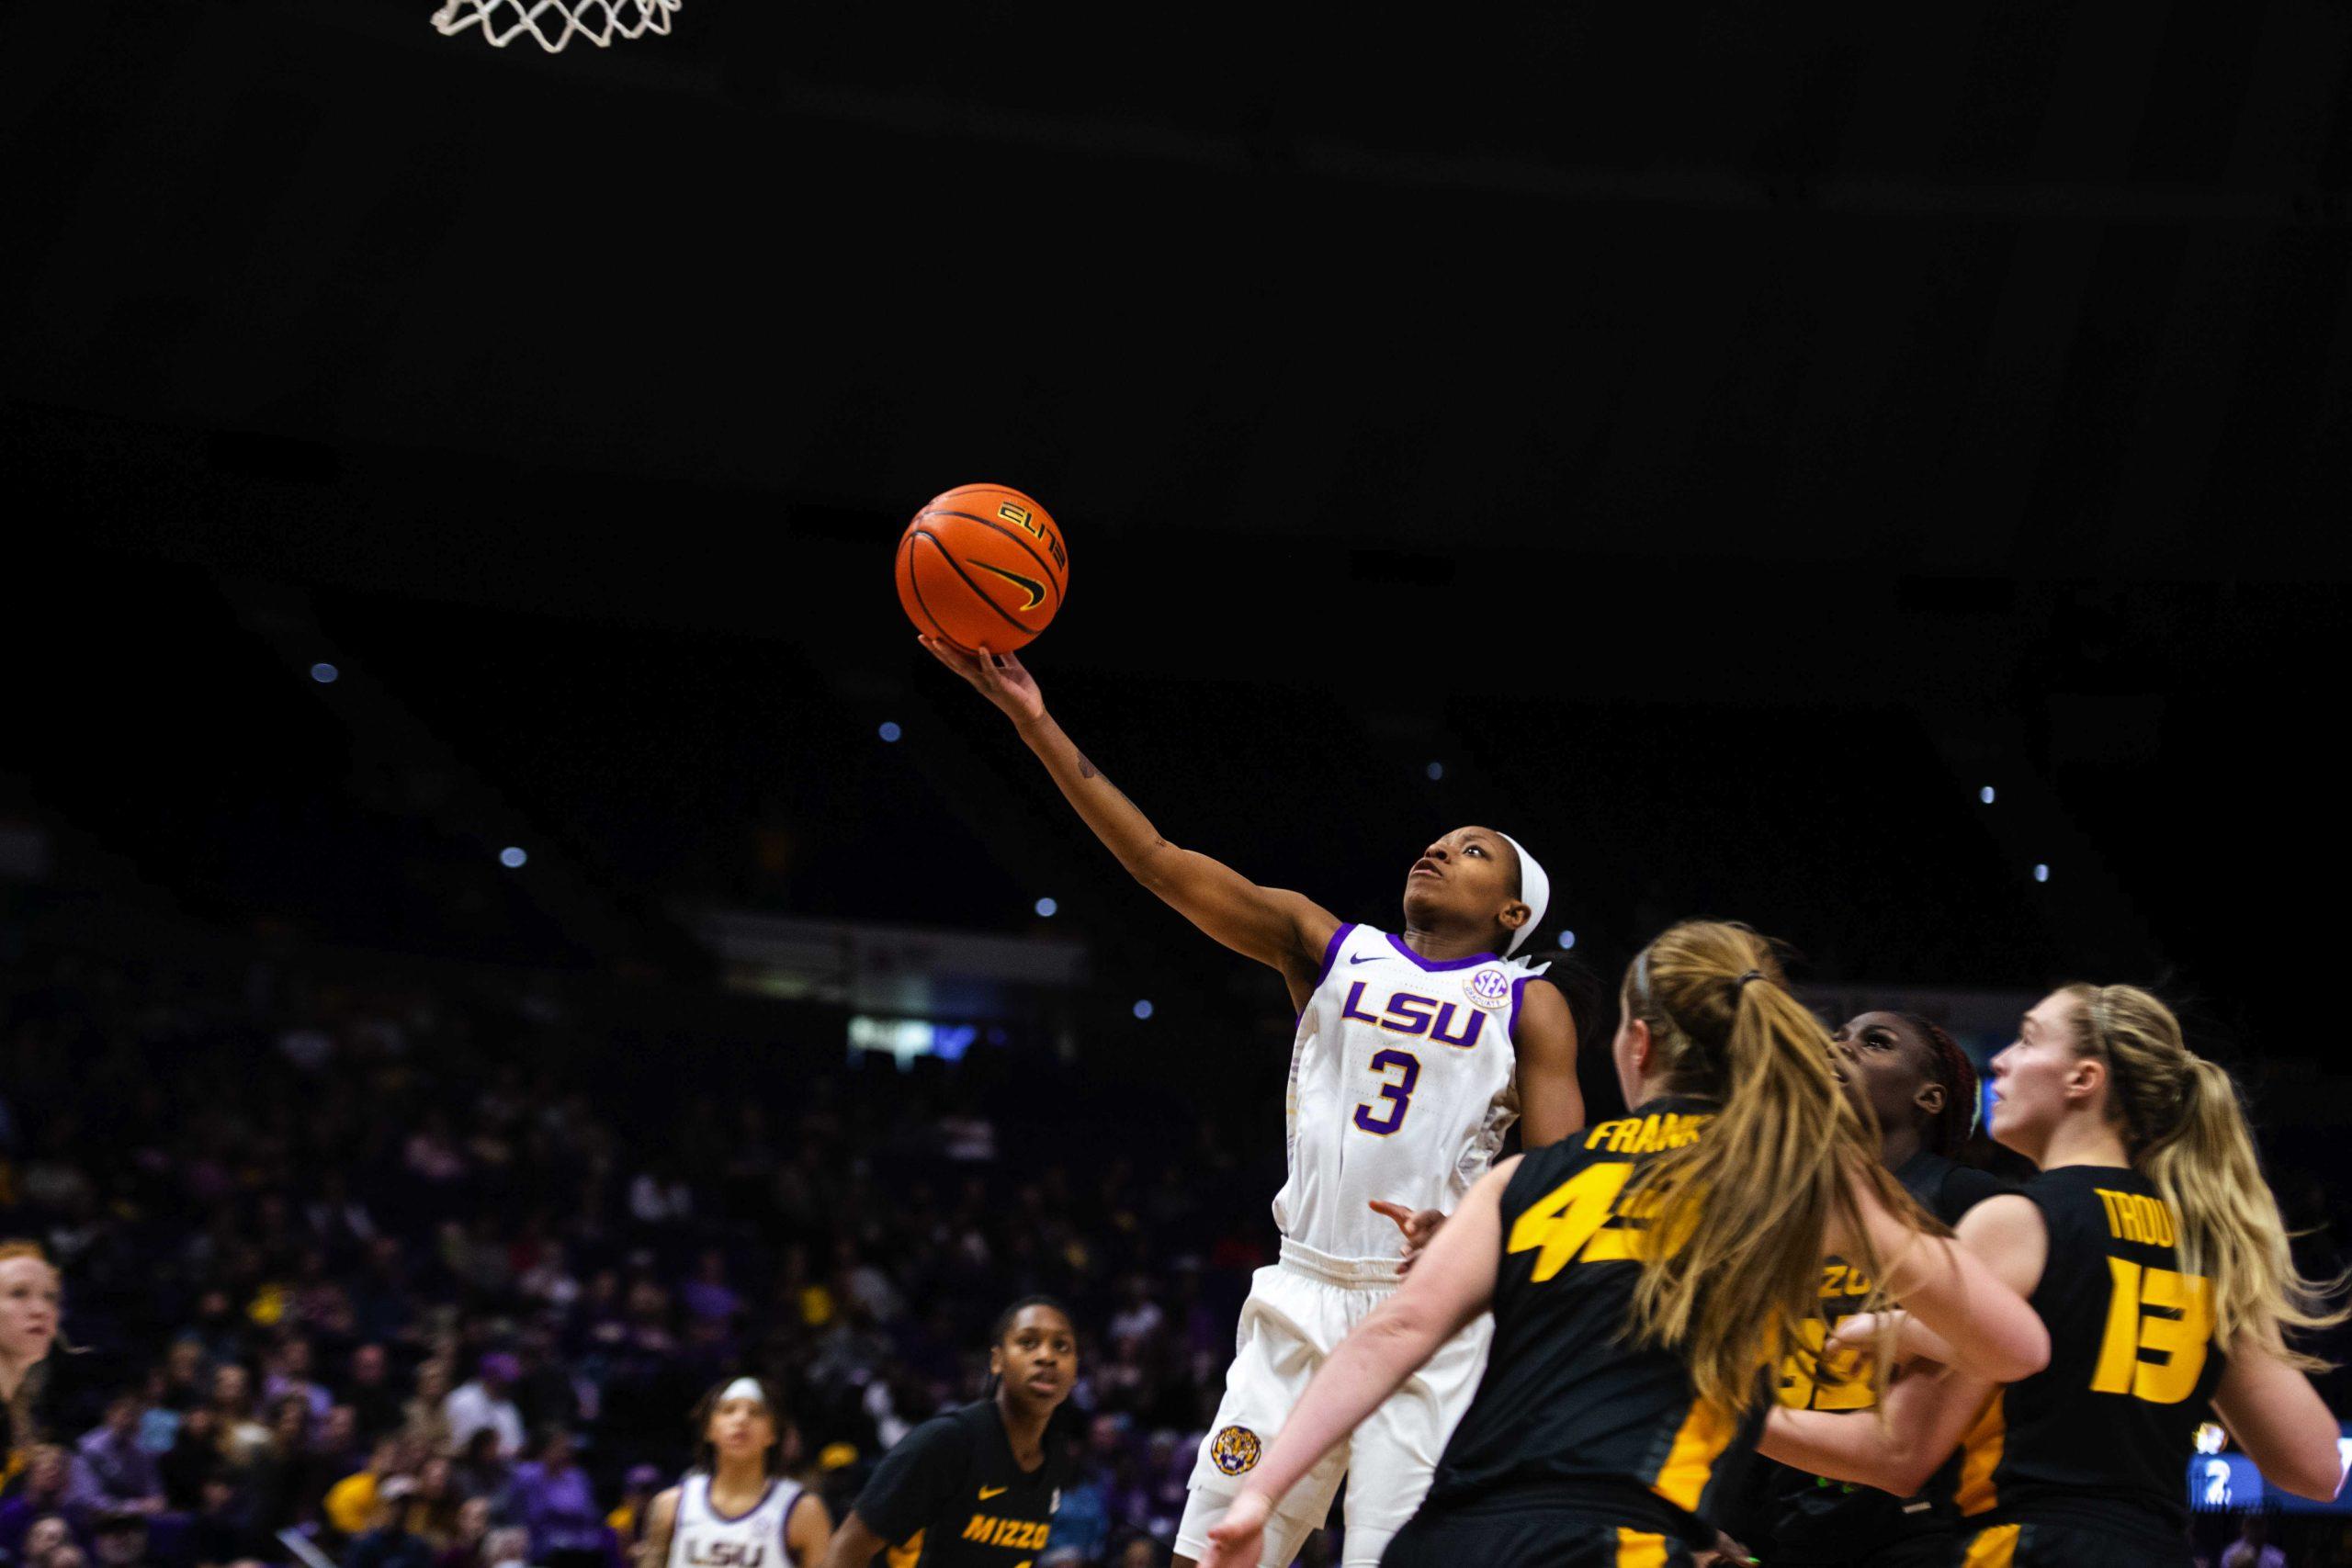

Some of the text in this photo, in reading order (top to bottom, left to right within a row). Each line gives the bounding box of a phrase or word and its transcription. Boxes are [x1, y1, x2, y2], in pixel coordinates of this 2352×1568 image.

[998, 501, 1066, 572] ELITE
[1341, 980, 1487, 1050] LSU
[1474, 970, 1508, 998] SEC
[1352, 1048, 1420, 1137] 3
[2089, 1256, 2217, 1404] 13
[685, 1540, 765, 1568] LSU
[962, 1515, 1051, 1551] MIZZO
